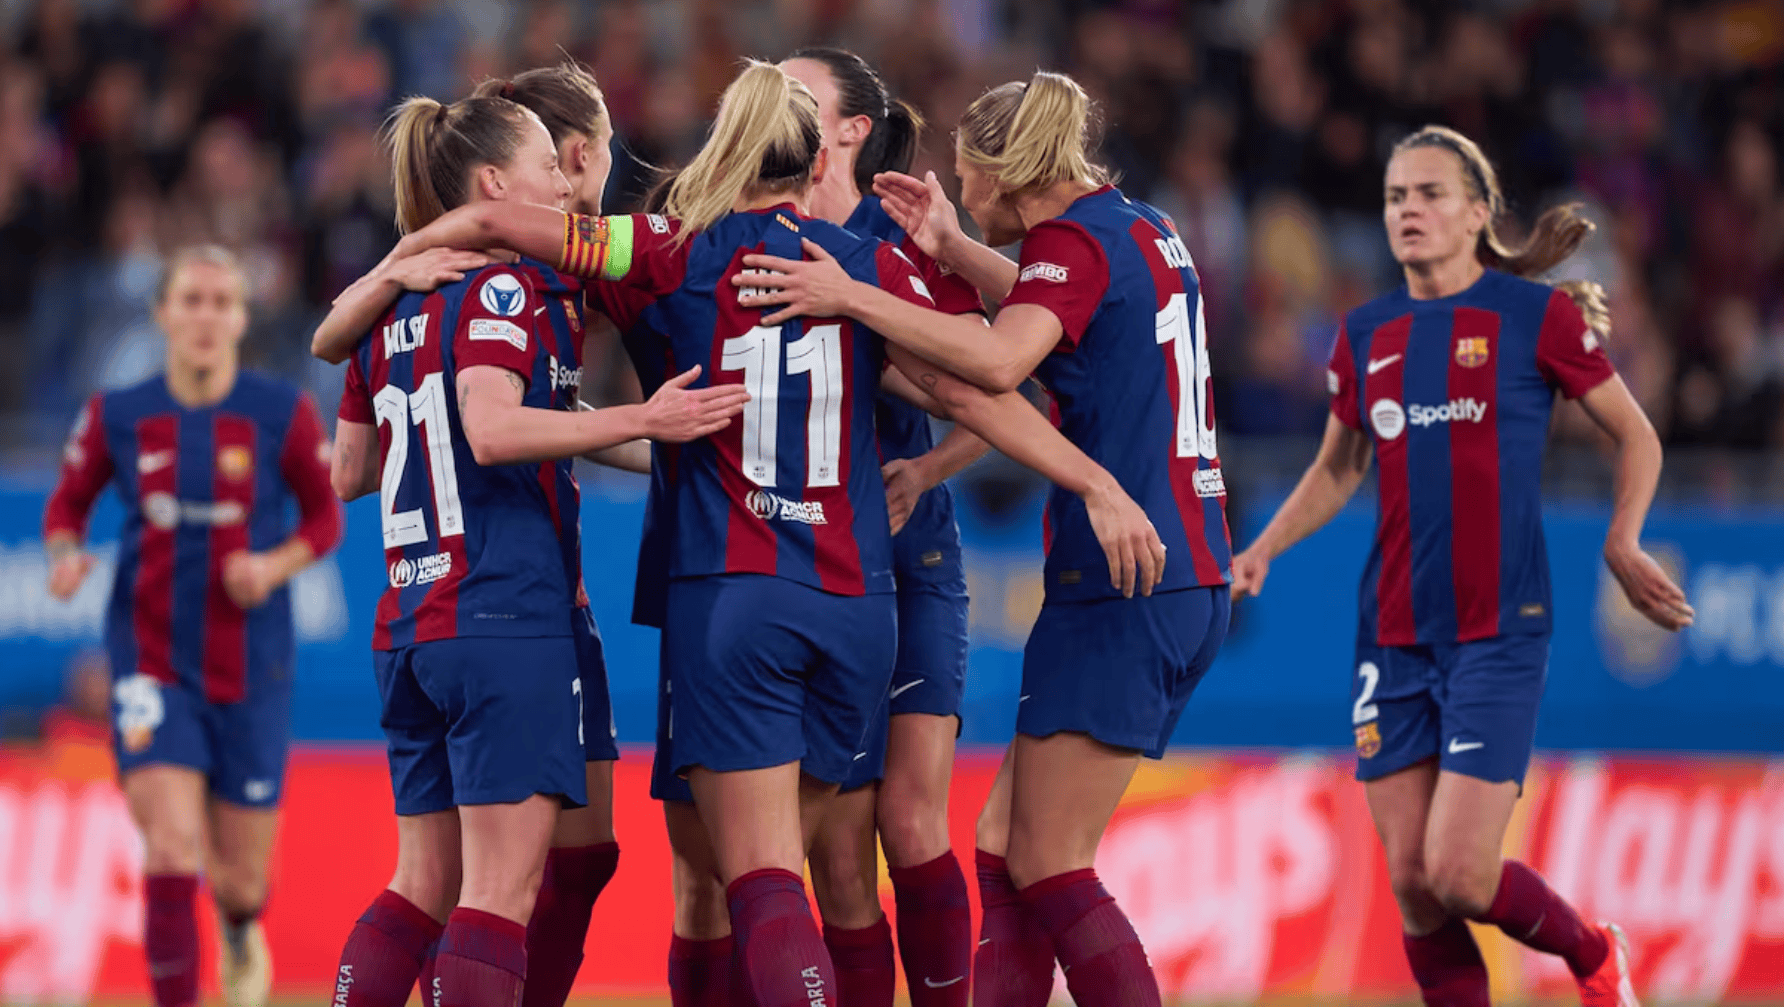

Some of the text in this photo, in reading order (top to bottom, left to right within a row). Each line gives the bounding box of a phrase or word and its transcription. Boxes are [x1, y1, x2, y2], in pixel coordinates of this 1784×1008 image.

[721, 324, 843, 487] 11
[1408, 397, 1487, 428] Spotify
[373, 371, 466, 549] 21
[777, 496, 823, 513] UNHCR
[781, 505, 827, 521] ACNUR
[416, 563, 451, 582] ACNUR
[417, 552, 451, 569] UNHCR
[1353, 662, 1379, 722] 2
[801, 965, 827, 1007] ARÇA
